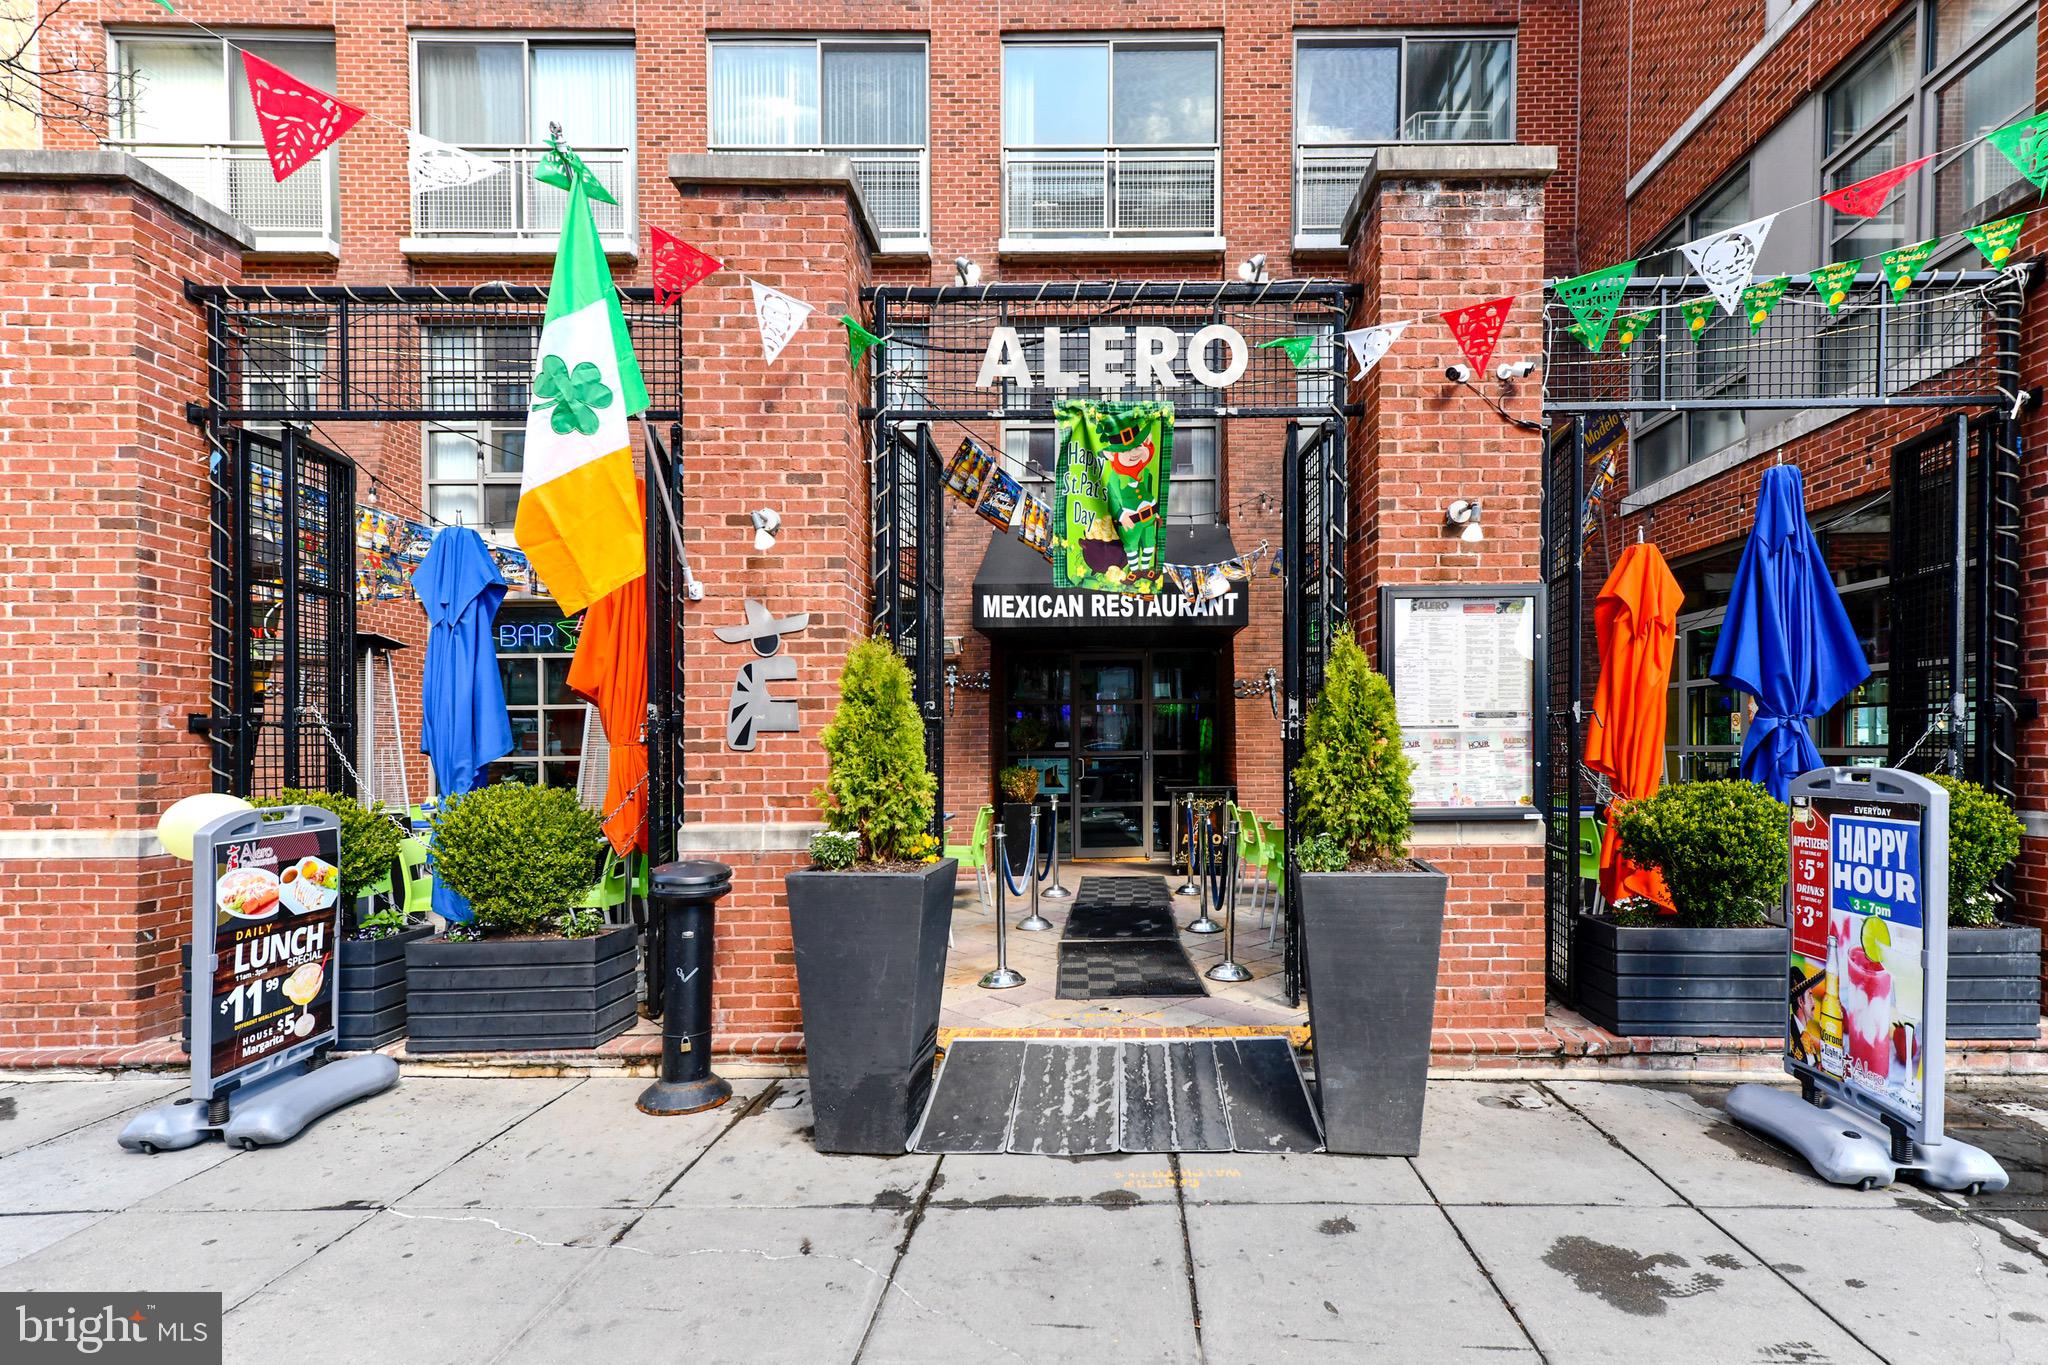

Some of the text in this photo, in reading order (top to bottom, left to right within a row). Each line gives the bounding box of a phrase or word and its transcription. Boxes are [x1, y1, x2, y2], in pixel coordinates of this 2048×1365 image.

[975, 323, 1249, 388] ALERO
[1584, 414, 1619, 447] Modelo
[1067, 441, 1105, 480] Happy
[1073, 501, 1096, 532] Day
[982, 593, 1239, 618] MEXICAN RESTAURANT
[1417, 601, 1449, 611] ALERO
[499, 624, 554, 647] BAR
[1468, 740, 1490, 749] HOUR
[1854, 806, 1892, 817] EVERYDAY
[1792, 835, 1829, 851] APPETIZERS
[1838, 824, 1909, 870] HAPPY
[1796, 882, 1825, 897] DRINKS
[1833, 861, 1917, 904] HOUR
[1853, 899, 1860, 911] 3
[1868, 902, 1892, 918] 7pm
[235, 923, 273, 941] DAILY
[234, 921, 325, 974] LUNCH
[286, 949, 323, 968] SPECIAL
[241, 1012, 296, 1047] HOUSE $5
[241, 1034, 285, 1059] Margarita
